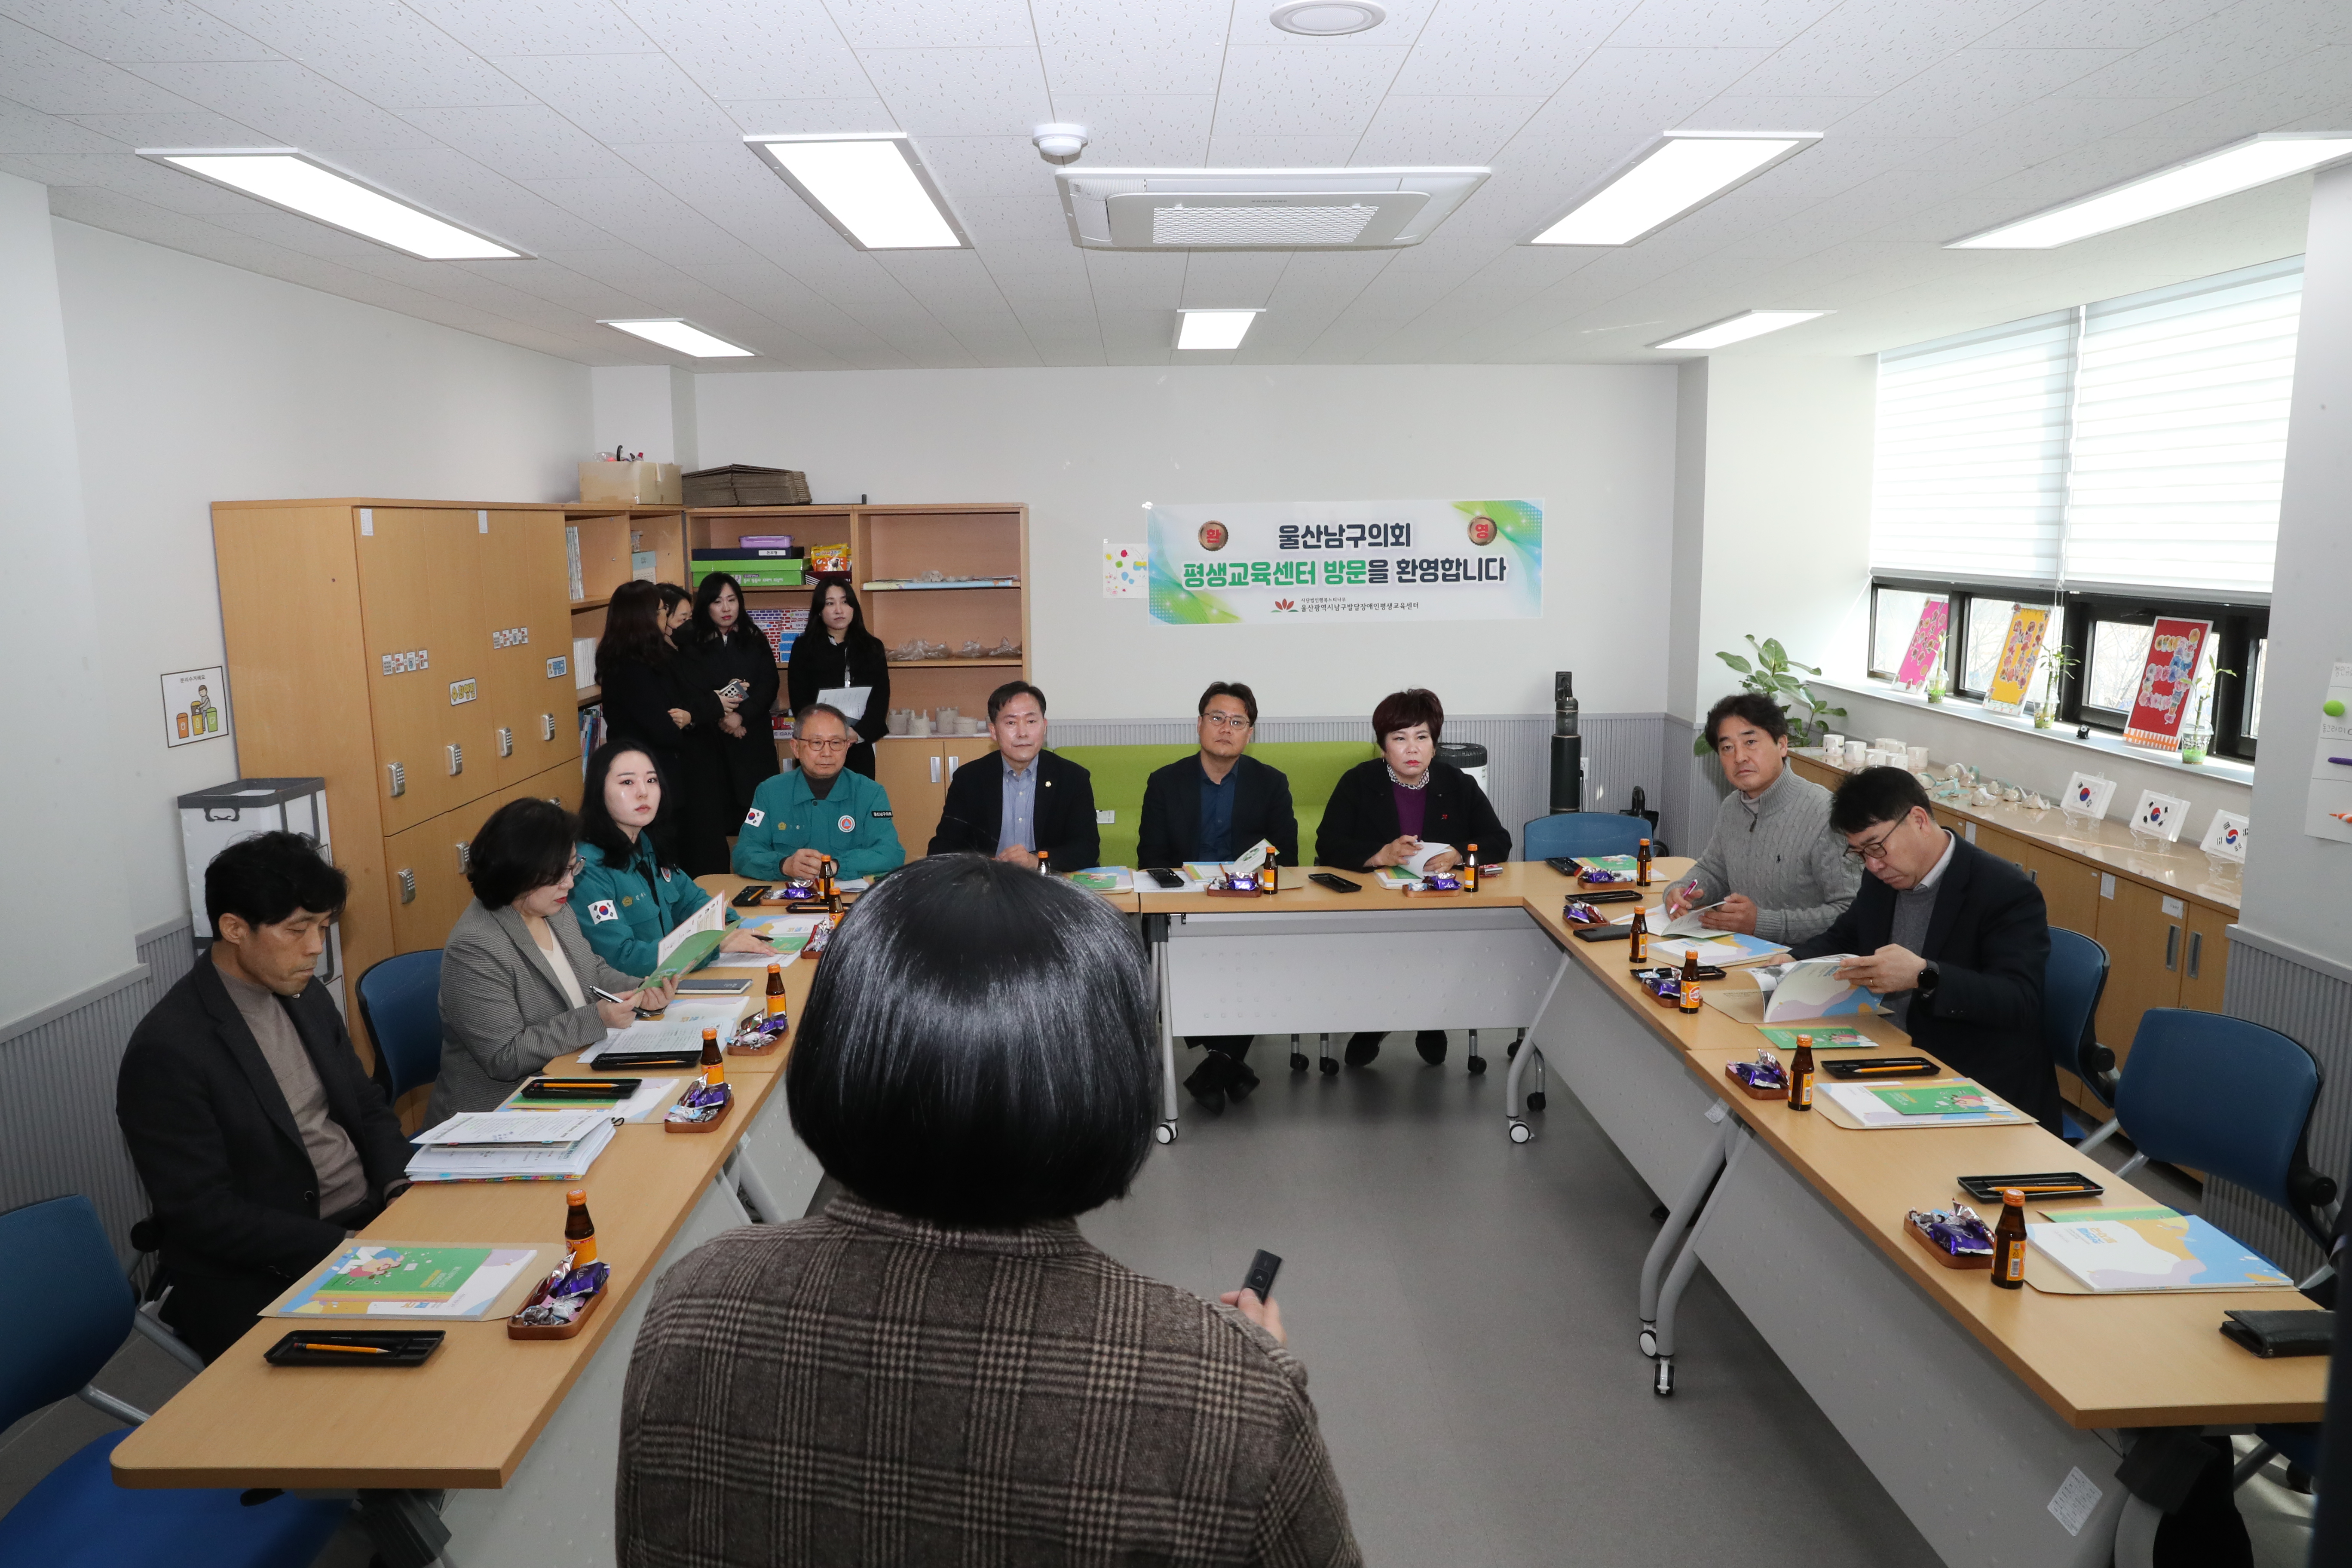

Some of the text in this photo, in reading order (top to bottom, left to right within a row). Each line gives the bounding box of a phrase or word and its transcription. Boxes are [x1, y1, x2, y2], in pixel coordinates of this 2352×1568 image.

[1207, 529, 1221, 543] 환
[1279, 523, 1410, 549] 울산남구의회
[1475, 524, 1488, 539] 영
[1183, 557, 1506, 587] 평생교육센터 방문을 환영합니다
[1301, 602, 1419, 612] 울산광역시남구발달장애인평생교육센터
[2323, 723, 2346, 733] 동그라미
